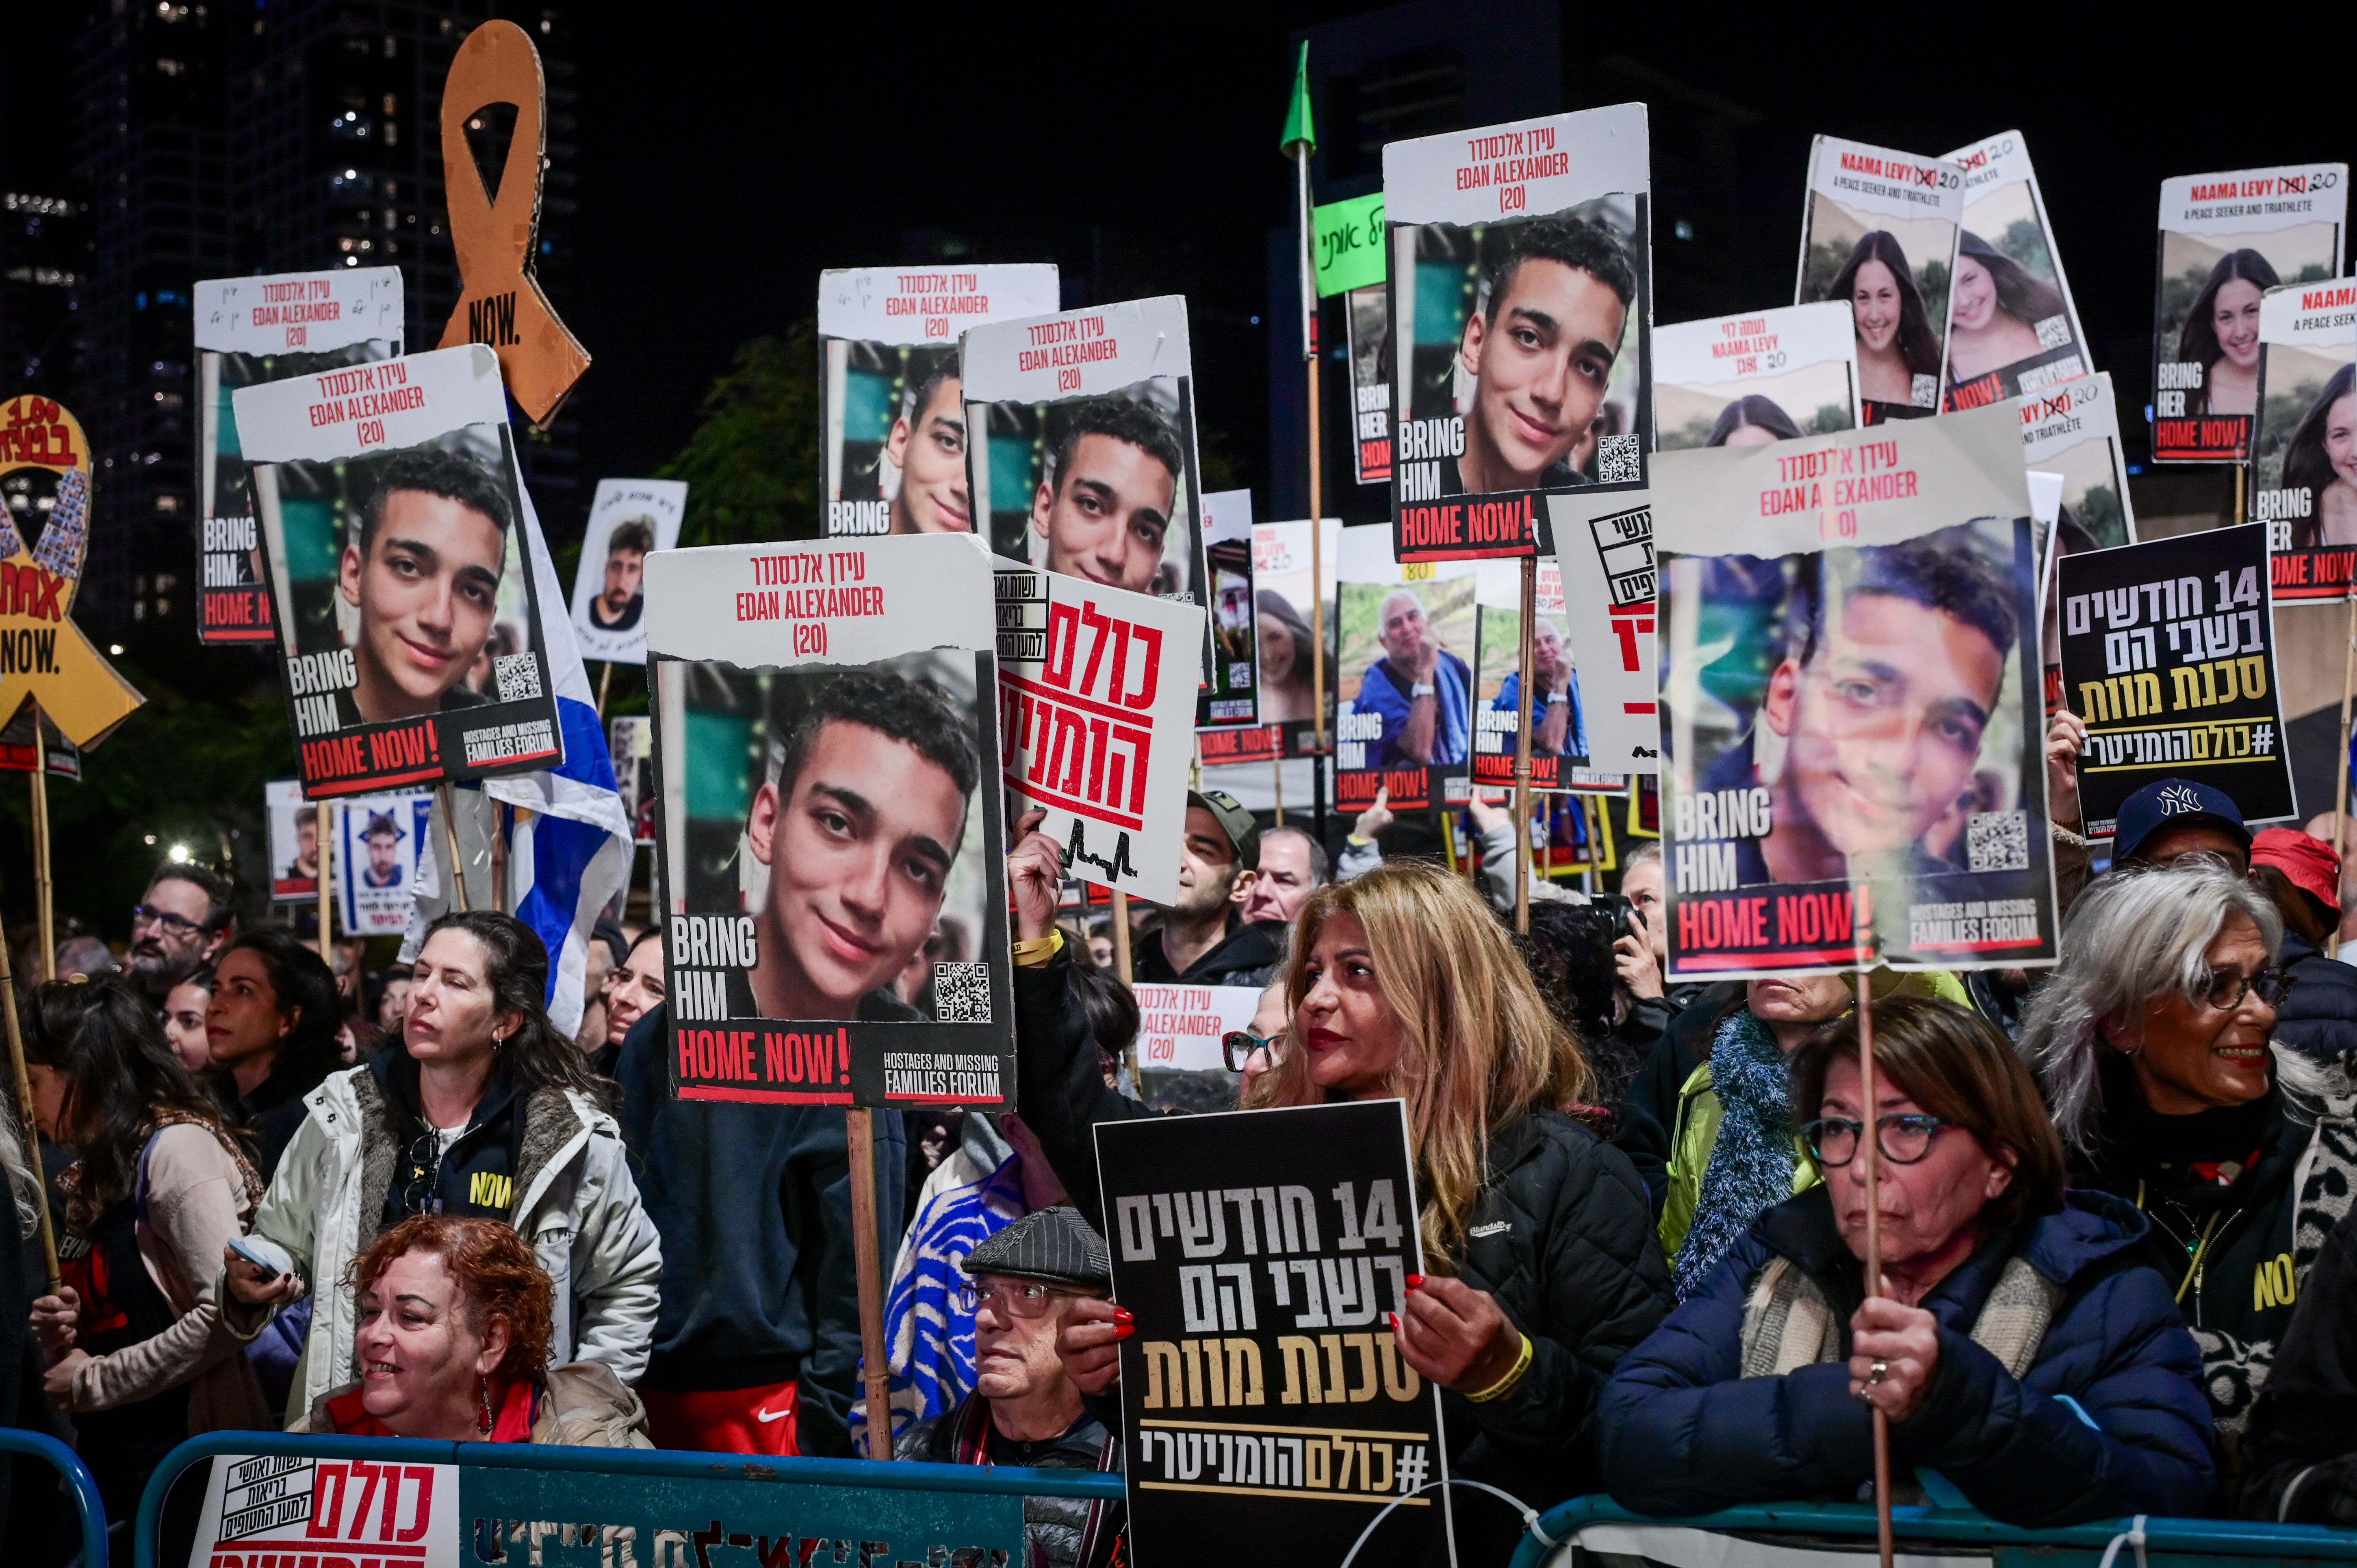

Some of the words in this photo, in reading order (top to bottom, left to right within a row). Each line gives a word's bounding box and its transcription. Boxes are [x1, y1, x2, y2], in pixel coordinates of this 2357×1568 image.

[1468, 132, 1524, 161] אלכסנדר
[1527, 127, 1555, 156] עידן
[1457, 167, 1490, 190] EDAN
[1493, 153, 1569, 185] ALEXANDER
[1841, 152, 1882, 178] NAAMA
[1885, 161, 1913, 181] LEVY
[1500, 185, 1526, 213] (20)
[2191, 182, 2237, 201] NAAMA
[2241, 179, 2274, 197] LEVY
[2308, 173, 2337, 192] 20
[2190, 207, 2214, 220] PEACE
[2215, 204, 2244, 218] SEEKER
[2264, 200, 2312, 214] TRIATHLETE
[262, 280, 305, 303] אלכסנדר
[308, 280, 330, 301] עידן
[897, 274, 948, 294] אלכסנדר
[952, 274, 976, 294] עידן
[252, 307, 279, 326] EDAN
[282, 301, 340, 323] ALEXANDER
[468, 291, 520, 346] NOW.
[886, 298, 916, 315] EDAN
[920, 296, 989, 314] ALEXANDER
[286, 325, 307, 347] (20)
[925, 317, 949, 338] (20)
[1027, 320, 1076, 347] אלכסנדר
[1080, 316, 1104, 340] עידן
[2294, 319, 2299, 331] A
[2303, 316, 2331, 330] PEACE
[1019, 351, 1049, 373] EDAN
[1052, 339, 1118, 366] ALEXANDER
[1712, 339, 1751, 359] NAAMA
[1752, 335, 1779, 354] LEVY
[1767, 350, 1787, 370] 20
[316, 368, 375, 399] אלכסנדר
[377, 362, 408, 395] עידן
[1058, 368, 1082, 393] (20)
[2158, 362, 2202, 390] BRING
[309, 401, 346, 427] EDAN
[349, 387, 426, 420] ALEXANDER
[2074, 384, 2098, 407] 20
[2158, 390, 2185, 417] HER
[357, 419, 385, 447] (20)
[1359, 410, 1388, 440] HER
[1399, 417, 1464, 459] BRING
[2036, 417, 2082, 441] TRIATHLETE
[2157, 420, 2197, 447] HOME
[2201, 416, 2246, 446] NOW!
[1776, 446, 1854, 483] אלכסנדר
[1858, 441, 1898, 476] עידן
[1400, 463, 1440, 502] HIM
[1760, 491, 1806, 517] EDAN
[1811, 471, 1918, 509] ALEXANDER
[828, 501, 890, 534] BRING
[2257, 487, 2311, 519] BRING
[204, 517, 257, 551] BRING
[1401, 505, 1461, 546] HOME
[1468, 495, 1533, 543] NOW!
[1819, 511, 1858, 541] (20)
[204, 553, 239, 588] HIM
[750, 553, 824, 586] אלכסנדר
[828, 552, 865, 587] עידן
[1010, 576, 1036, 598] נשות
[2214, 566, 2261, 613] 14
[204, 591, 254, 626] HOME
[736, 591, 779, 622] EDAN
[785, 586, 885, 619] ALEXANDER
[2066, 575, 2203, 636] חודשים
[1, 628, 60, 674] NOW.
[793, 622, 828, 657] (20)
[1017, 631, 1042, 656] למען
[2105, 627, 2157, 674] הם
[2166, 610, 2264, 662] בשבי
[1041, 600, 1162, 710] כולם
[286, 648, 358, 695] BRING
[2171, 655, 2266, 711] סכנת
[2079, 673, 2162, 723] מוות
[294, 694, 340, 737] HIM
[463, 728, 500, 743] HOSTAGES
[502, 726, 516, 739] AND
[518, 719, 551, 736] MISSING
[1336, 712, 1382, 741] BRING
[1476, 710, 1518, 733] BRING
[301, 735, 368, 781] HOME
[371, 719, 440, 771] NOW!
[465, 740, 514, 763] FAMILIES
[515, 734, 555, 755] FORUM
[1337, 742, 1366, 769] HIM
[1476, 732, 1503, 754] HIM
[1475, 755, 1514, 777] HOME
[1337, 772, 1381, 800] HOME
[1383, 766, 1428, 799] NOW!
[1675, 787, 1772, 842] BRING
[1676, 842, 1738, 894] HIM
[1678, 897, 1768, 950] HOME
[1777, 884, 1873, 944] NOW!
[1966, 901, 1987, 918] AND
[671, 916, 757, 968] BRING
[1910, 918, 1980, 945] FAMILIES
[1981, 916, 2039, 942] FORUM
[674, 970, 728, 1022] HIM
[1183, 990, 1212, 1011] עידן
[1145, 1013, 1221, 1037] ALEXANDER
[677, 1029, 757, 1081] HOME
[764, 1028, 851, 1086] NOW!
[884, 1053, 932, 1071] HOSTAGES
[933, 1054, 953, 1071] AND
[955, 1055, 999, 1072] MISSING
[1148, 1037, 1175, 1061] (20)
[885, 1070, 947, 1095] FAMILIES
[950, 1072, 1001, 1098] FORUM
[1116, 1185, 1321, 1262] חודשים
[1332, 1179, 1404, 1251] 14
[1470, 1220, 1512, 1235] Blundstoe
[1178, 1263, 1257, 1332] הם
[1268, 1255, 1407, 1328] בשבי
[1142, 1337, 1265, 1409] מוות
[239, 1458, 270, 1483] ואנשי
[1140, 1430, 1430, 1493] #כולםהומניטרי
[246, 1477, 286, 1507] בריאות
[305, 1460, 435, 1542] כולם
[225, 1505, 274, 1538] החטופים
[277, 1495, 307, 1523] למען
